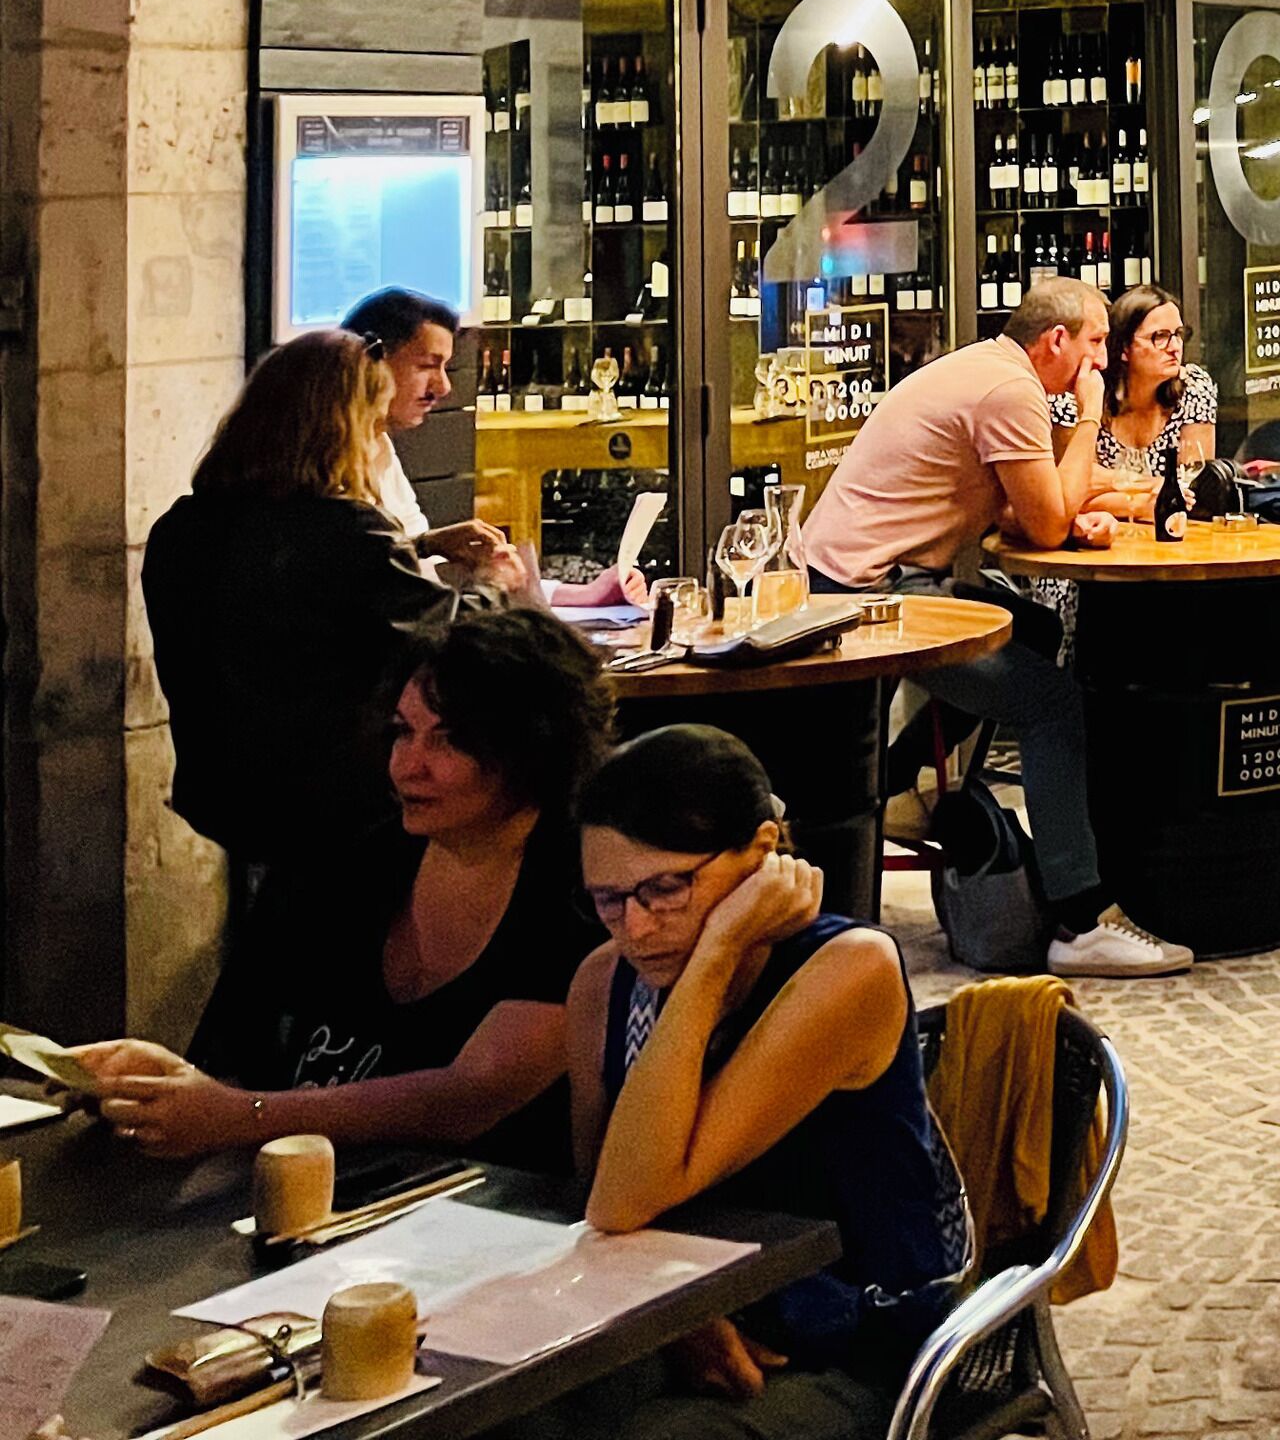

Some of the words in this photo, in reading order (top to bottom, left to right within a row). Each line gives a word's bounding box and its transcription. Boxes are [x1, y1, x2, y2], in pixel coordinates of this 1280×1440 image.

[824, 321, 872, 342] MIDI
[824, 344, 872, 365] MINUIT
[826, 378, 872, 400] 1200
[824, 402, 872, 423] 0000
